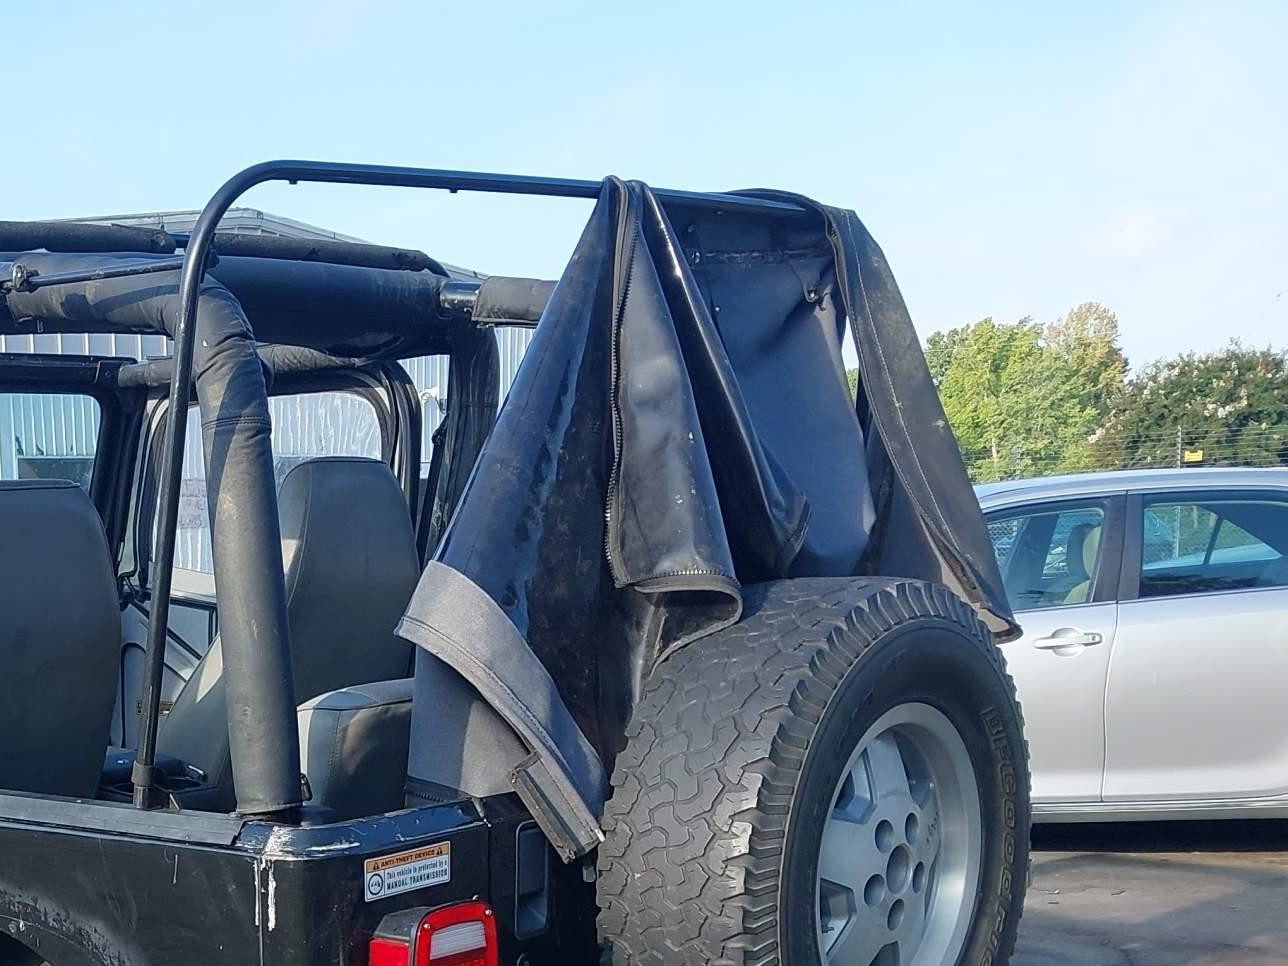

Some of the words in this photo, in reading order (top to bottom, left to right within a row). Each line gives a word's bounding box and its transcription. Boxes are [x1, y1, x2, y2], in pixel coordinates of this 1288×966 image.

[414, 849, 435, 860] DEVICE
[386, 878, 408, 890] MANUAL
[410, 869, 448, 885] TRANSMISSION
